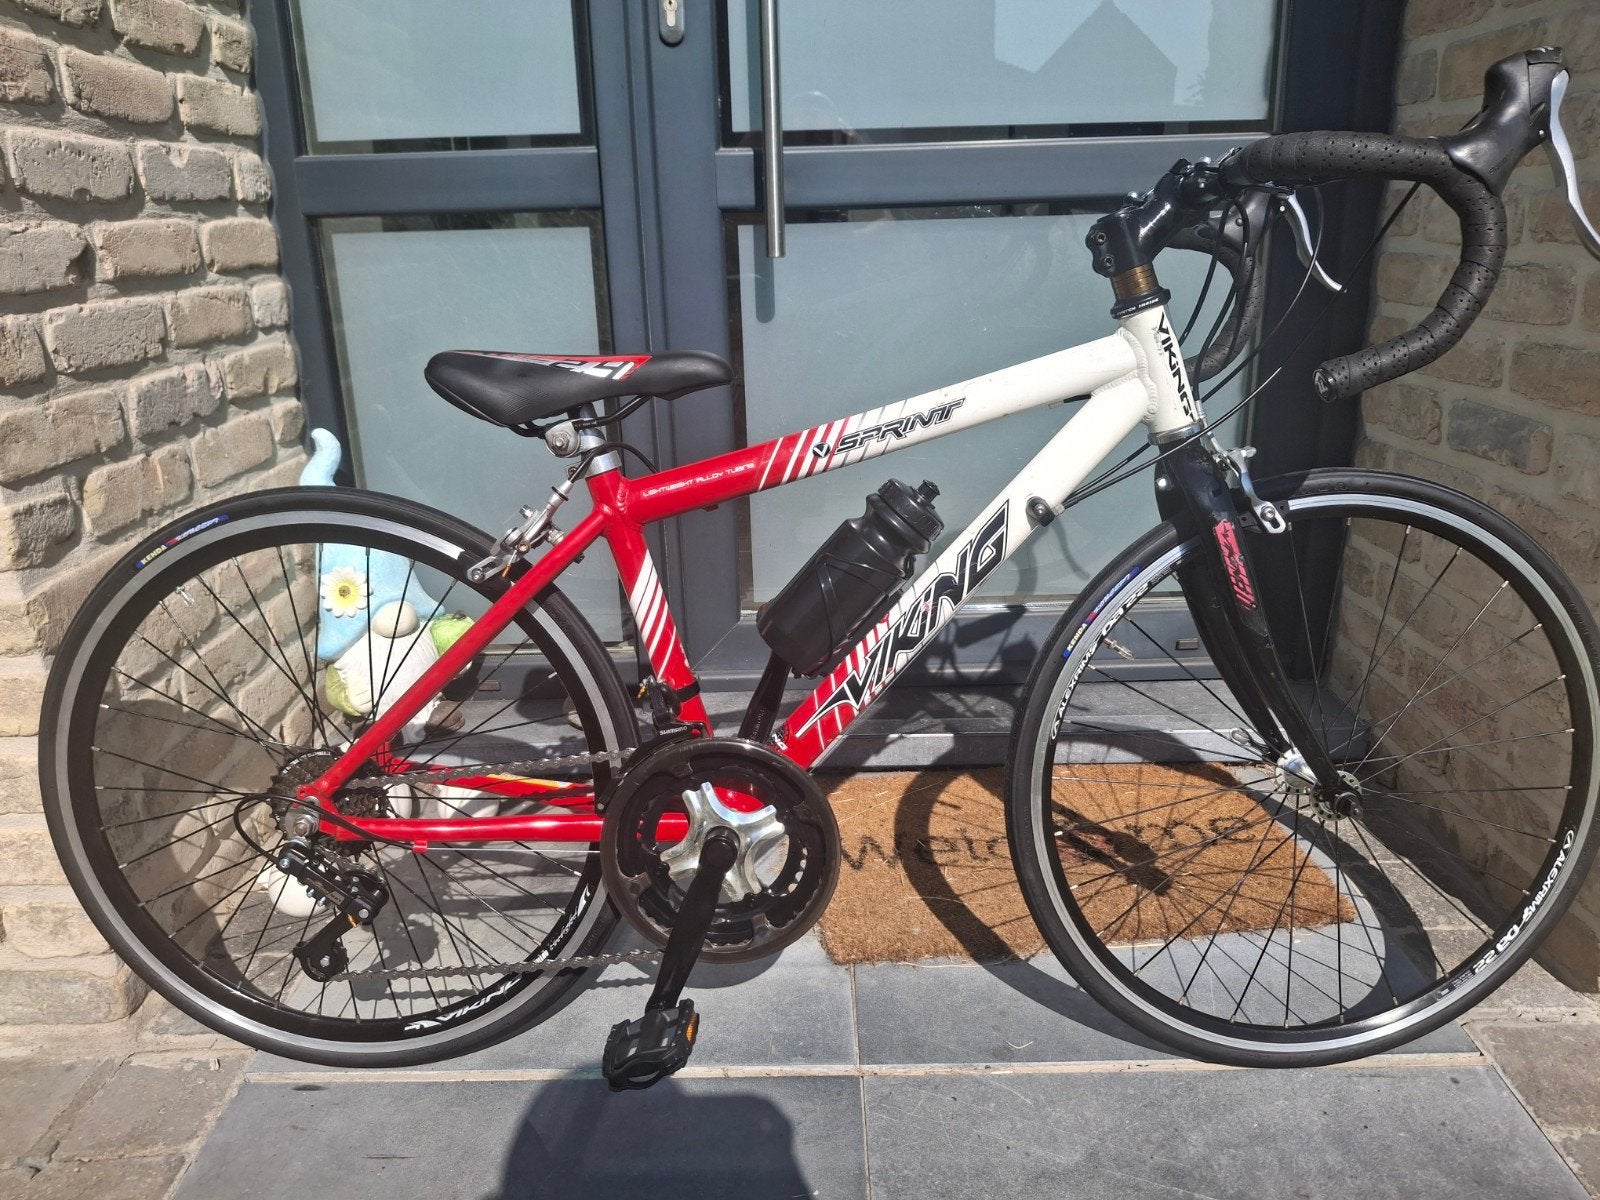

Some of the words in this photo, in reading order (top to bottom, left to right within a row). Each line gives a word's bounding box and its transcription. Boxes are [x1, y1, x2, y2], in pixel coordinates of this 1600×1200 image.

[834, 397, 966, 455] SPRINT
[140, 544, 167, 565] KENDA
[796, 499, 1010, 737] VIKING
[1067, 624, 1088, 651] KENDA
[1522, 849, 1566, 922] ALEXRIMS
